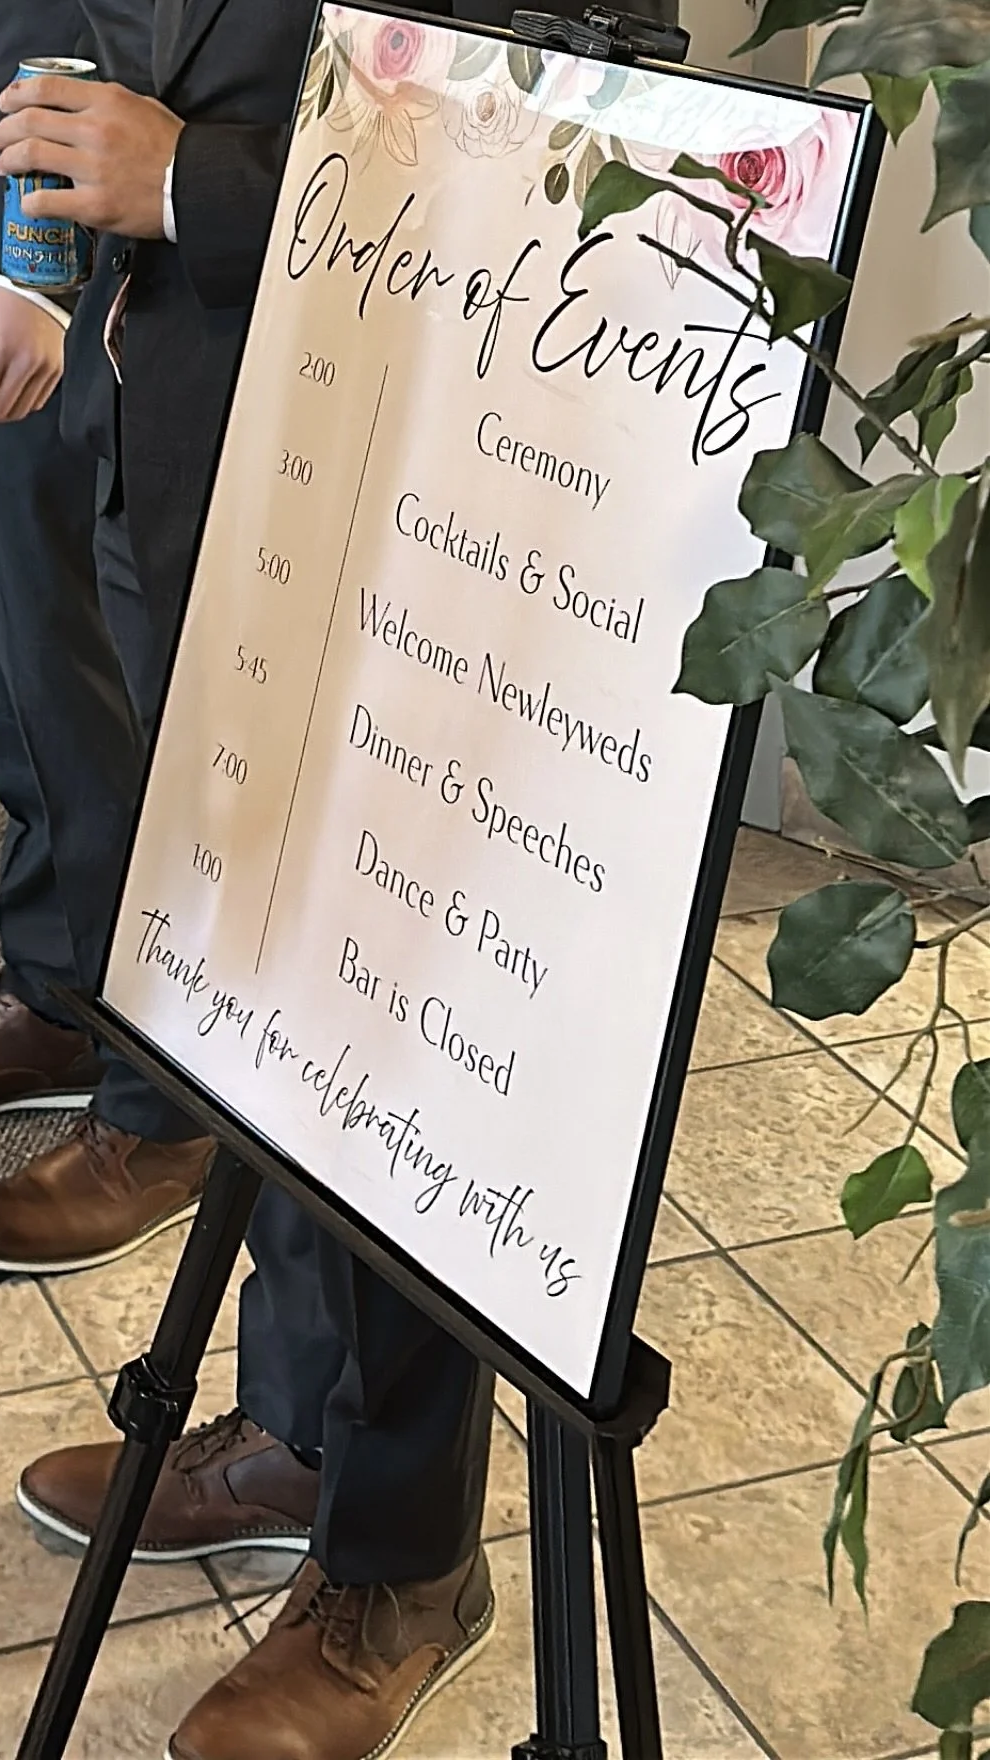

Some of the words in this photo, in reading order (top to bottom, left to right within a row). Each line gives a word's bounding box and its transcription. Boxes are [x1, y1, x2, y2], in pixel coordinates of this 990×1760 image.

[7, 221, 75, 244] PUNCH
[287, 152, 456, 320] Order
[463, 238, 542, 380] of
[531, 232, 783, 467] Events
[298, 351, 336, 388] 2:00
[277, 448, 313, 486] 3:00
[476, 411, 611, 512] Ceremony
[256, 546, 291, 585] 5:00
[395, 492, 510, 582] Cocktails
[519, 549, 546, 595] &
[552, 563, 646, 645] Social
[234, 644, 267, 685] 5:45
[360, 586, 469, 686] Welcome
[477, 652, 653, 784] Newleyweds
[211, 743, 248, 785] 7:00
[349, 703, 434, 789] Dinner
[440, 759, 466, 805] &
[471, 776, 607, 894] Speeches
[191, 842, 223, 883] 1:00
[355, 829, 435, 920] Dance
[444, 889, 470, 937] &
[477, 908, 550, 1000] Party
[338, 936, 383, 1002] Bar
[388, 980, 410, 1023] is
[420, 996, 514, 1098] Closed
[136, 908, 210, 1003] Thank
[197, 984, 255, 1040] you
[256, 1009, 300, 1069] for
[301, 1044, 458, 1214] celebrating
[459, 1180, 535, 1258] with
[539, 1243, 583, 1298] us
